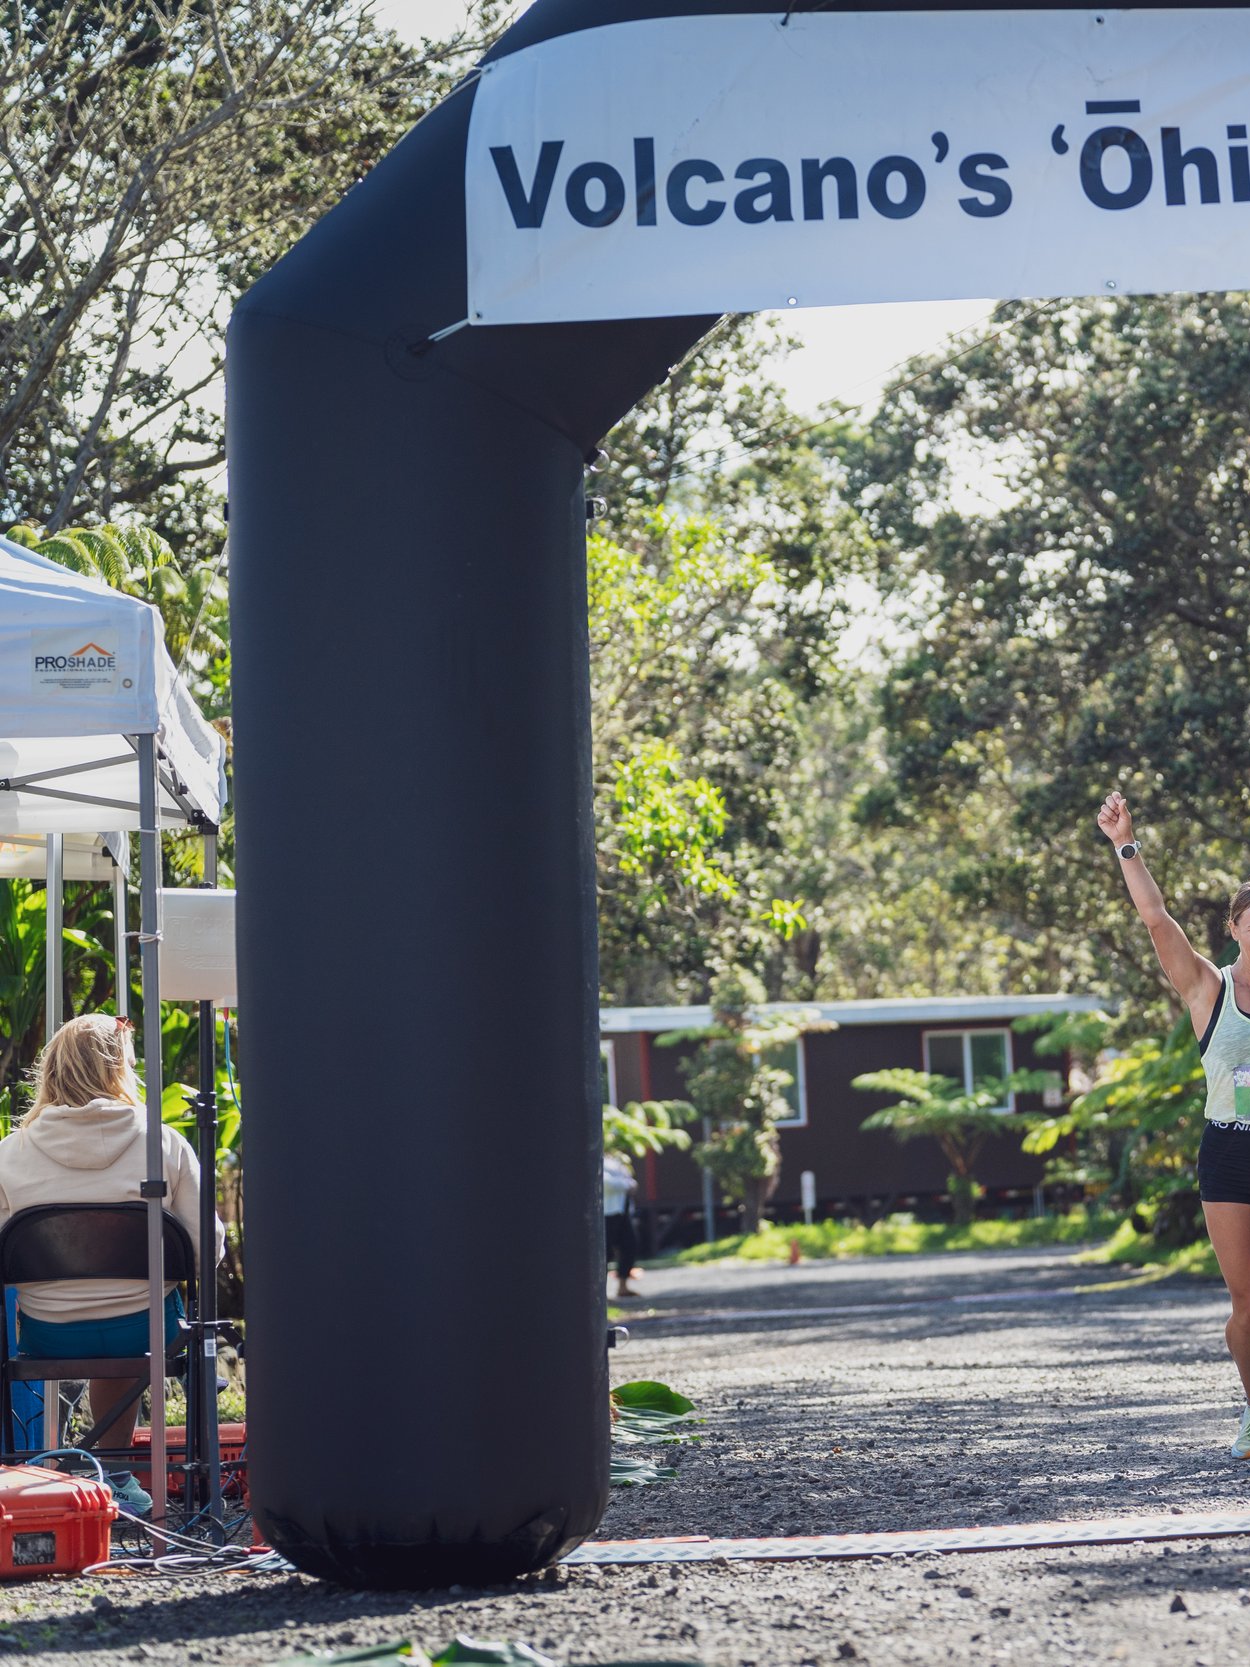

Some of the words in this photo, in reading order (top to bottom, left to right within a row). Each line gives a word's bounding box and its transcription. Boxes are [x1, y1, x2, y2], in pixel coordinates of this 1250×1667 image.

[489, 130, 1013, 230] Volcano’s
[35, 656, 116, 669] PROSHADE
[112, 1490, 129, 1502] HOKA
